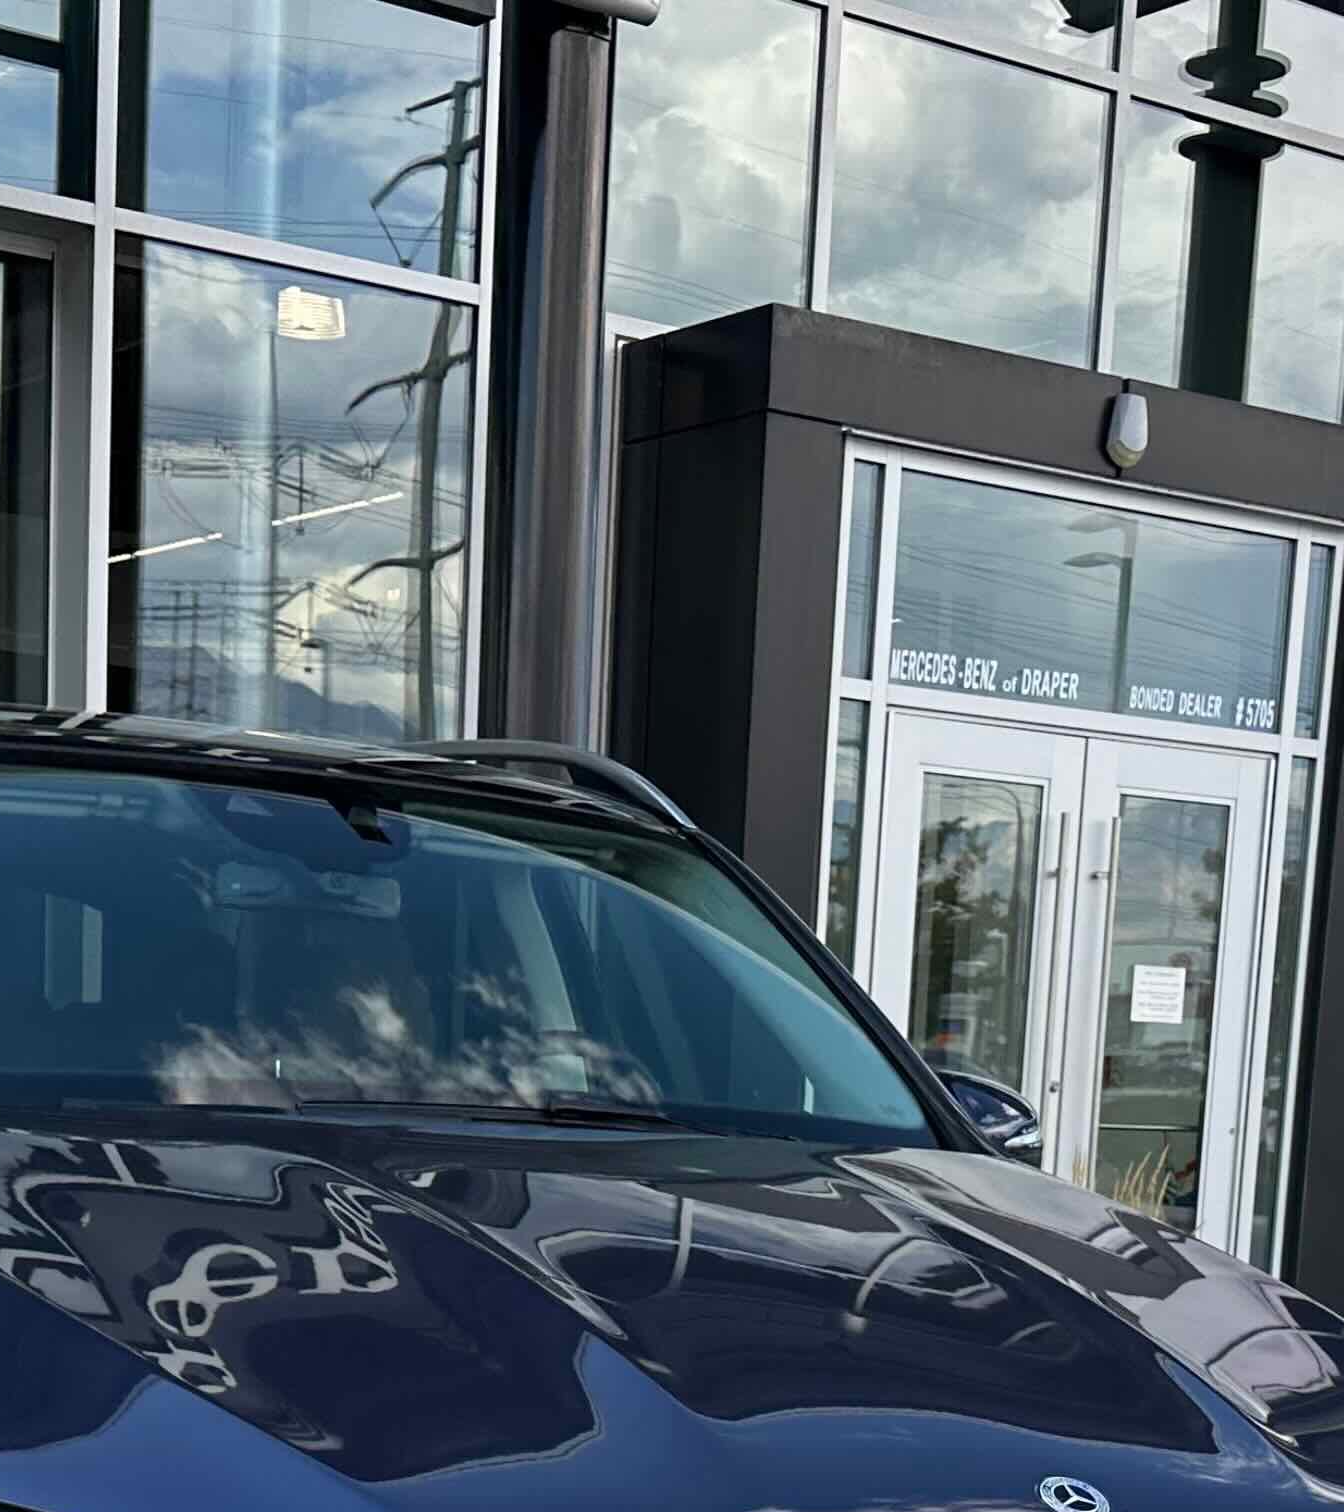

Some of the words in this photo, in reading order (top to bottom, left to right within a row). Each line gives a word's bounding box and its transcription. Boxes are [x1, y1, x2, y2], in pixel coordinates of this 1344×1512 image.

[1002, 676, 1019, 693] of
[1021, 668, 1080, 700] DRAPER
[1129, 685, 1175, 713] BONDED
[1178, 691, 1222, 719] DEALER
